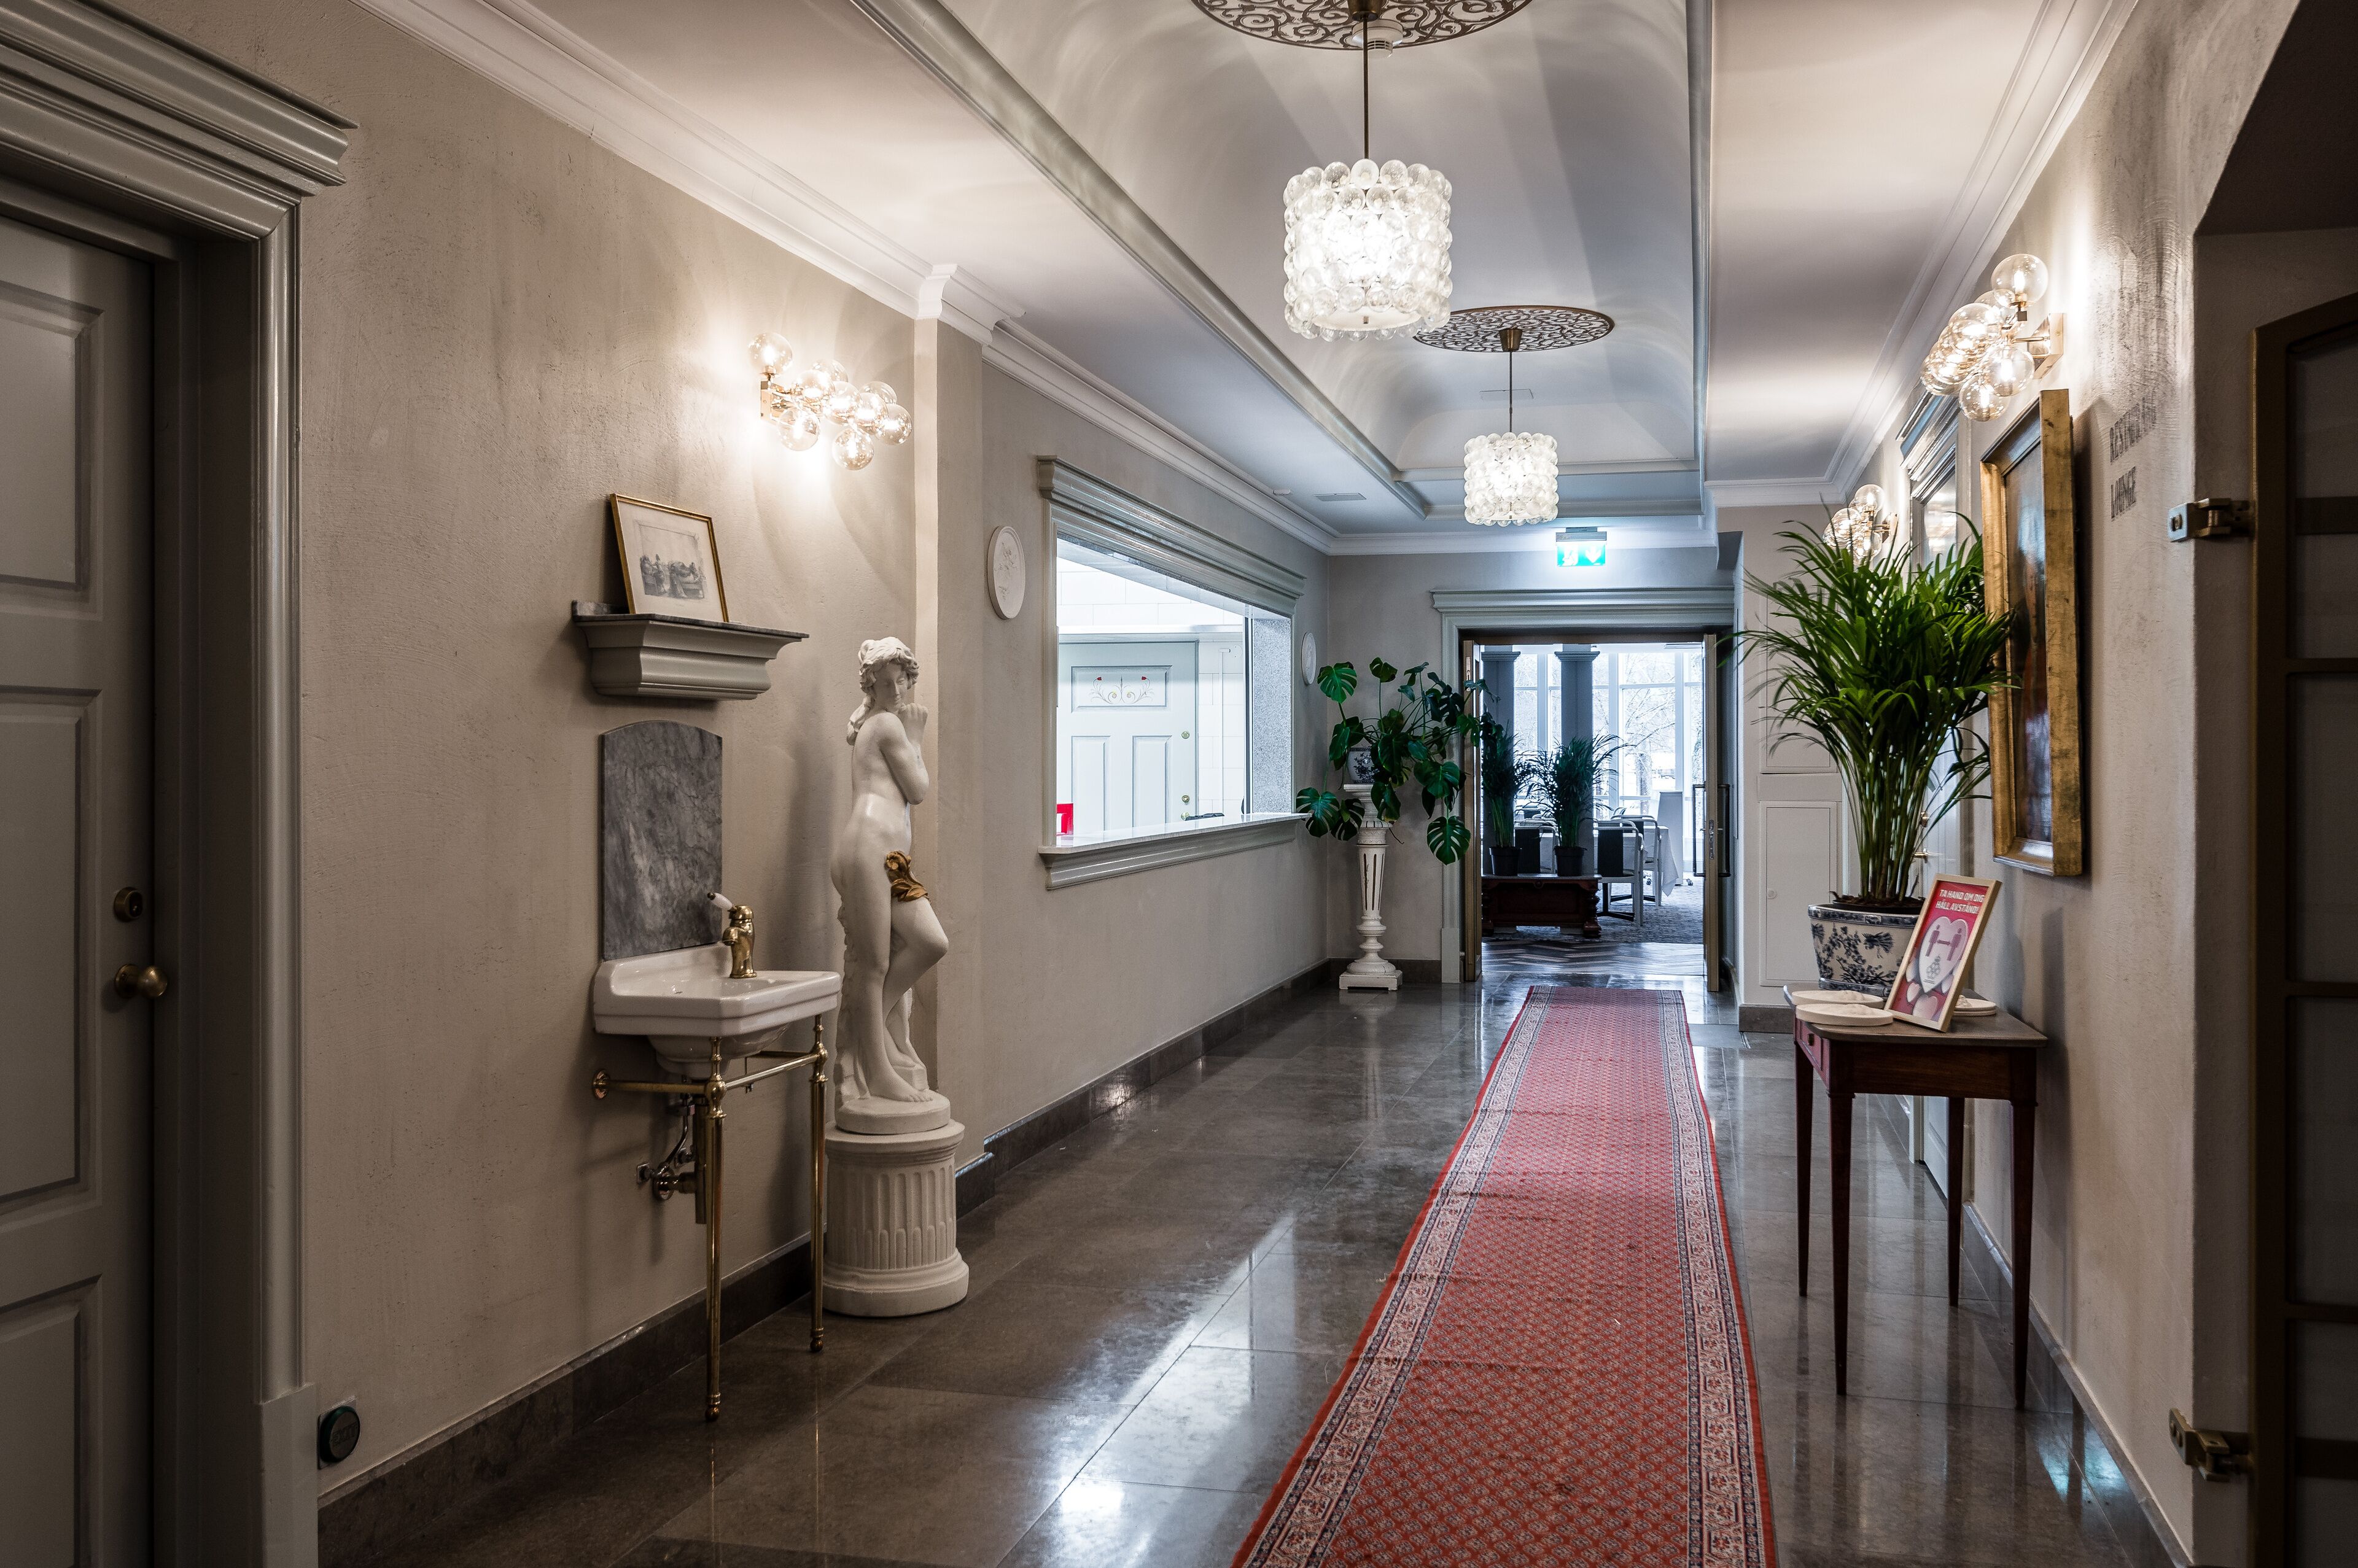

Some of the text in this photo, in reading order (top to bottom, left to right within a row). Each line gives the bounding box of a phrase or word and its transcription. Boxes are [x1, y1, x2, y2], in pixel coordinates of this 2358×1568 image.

[1940, 889, 1947, 898] TA
[1947, 890, 1964, 900] HAND
[1964, 892, 1974, 901] OM
[1936, 899, 1950, 910] HÅLL
